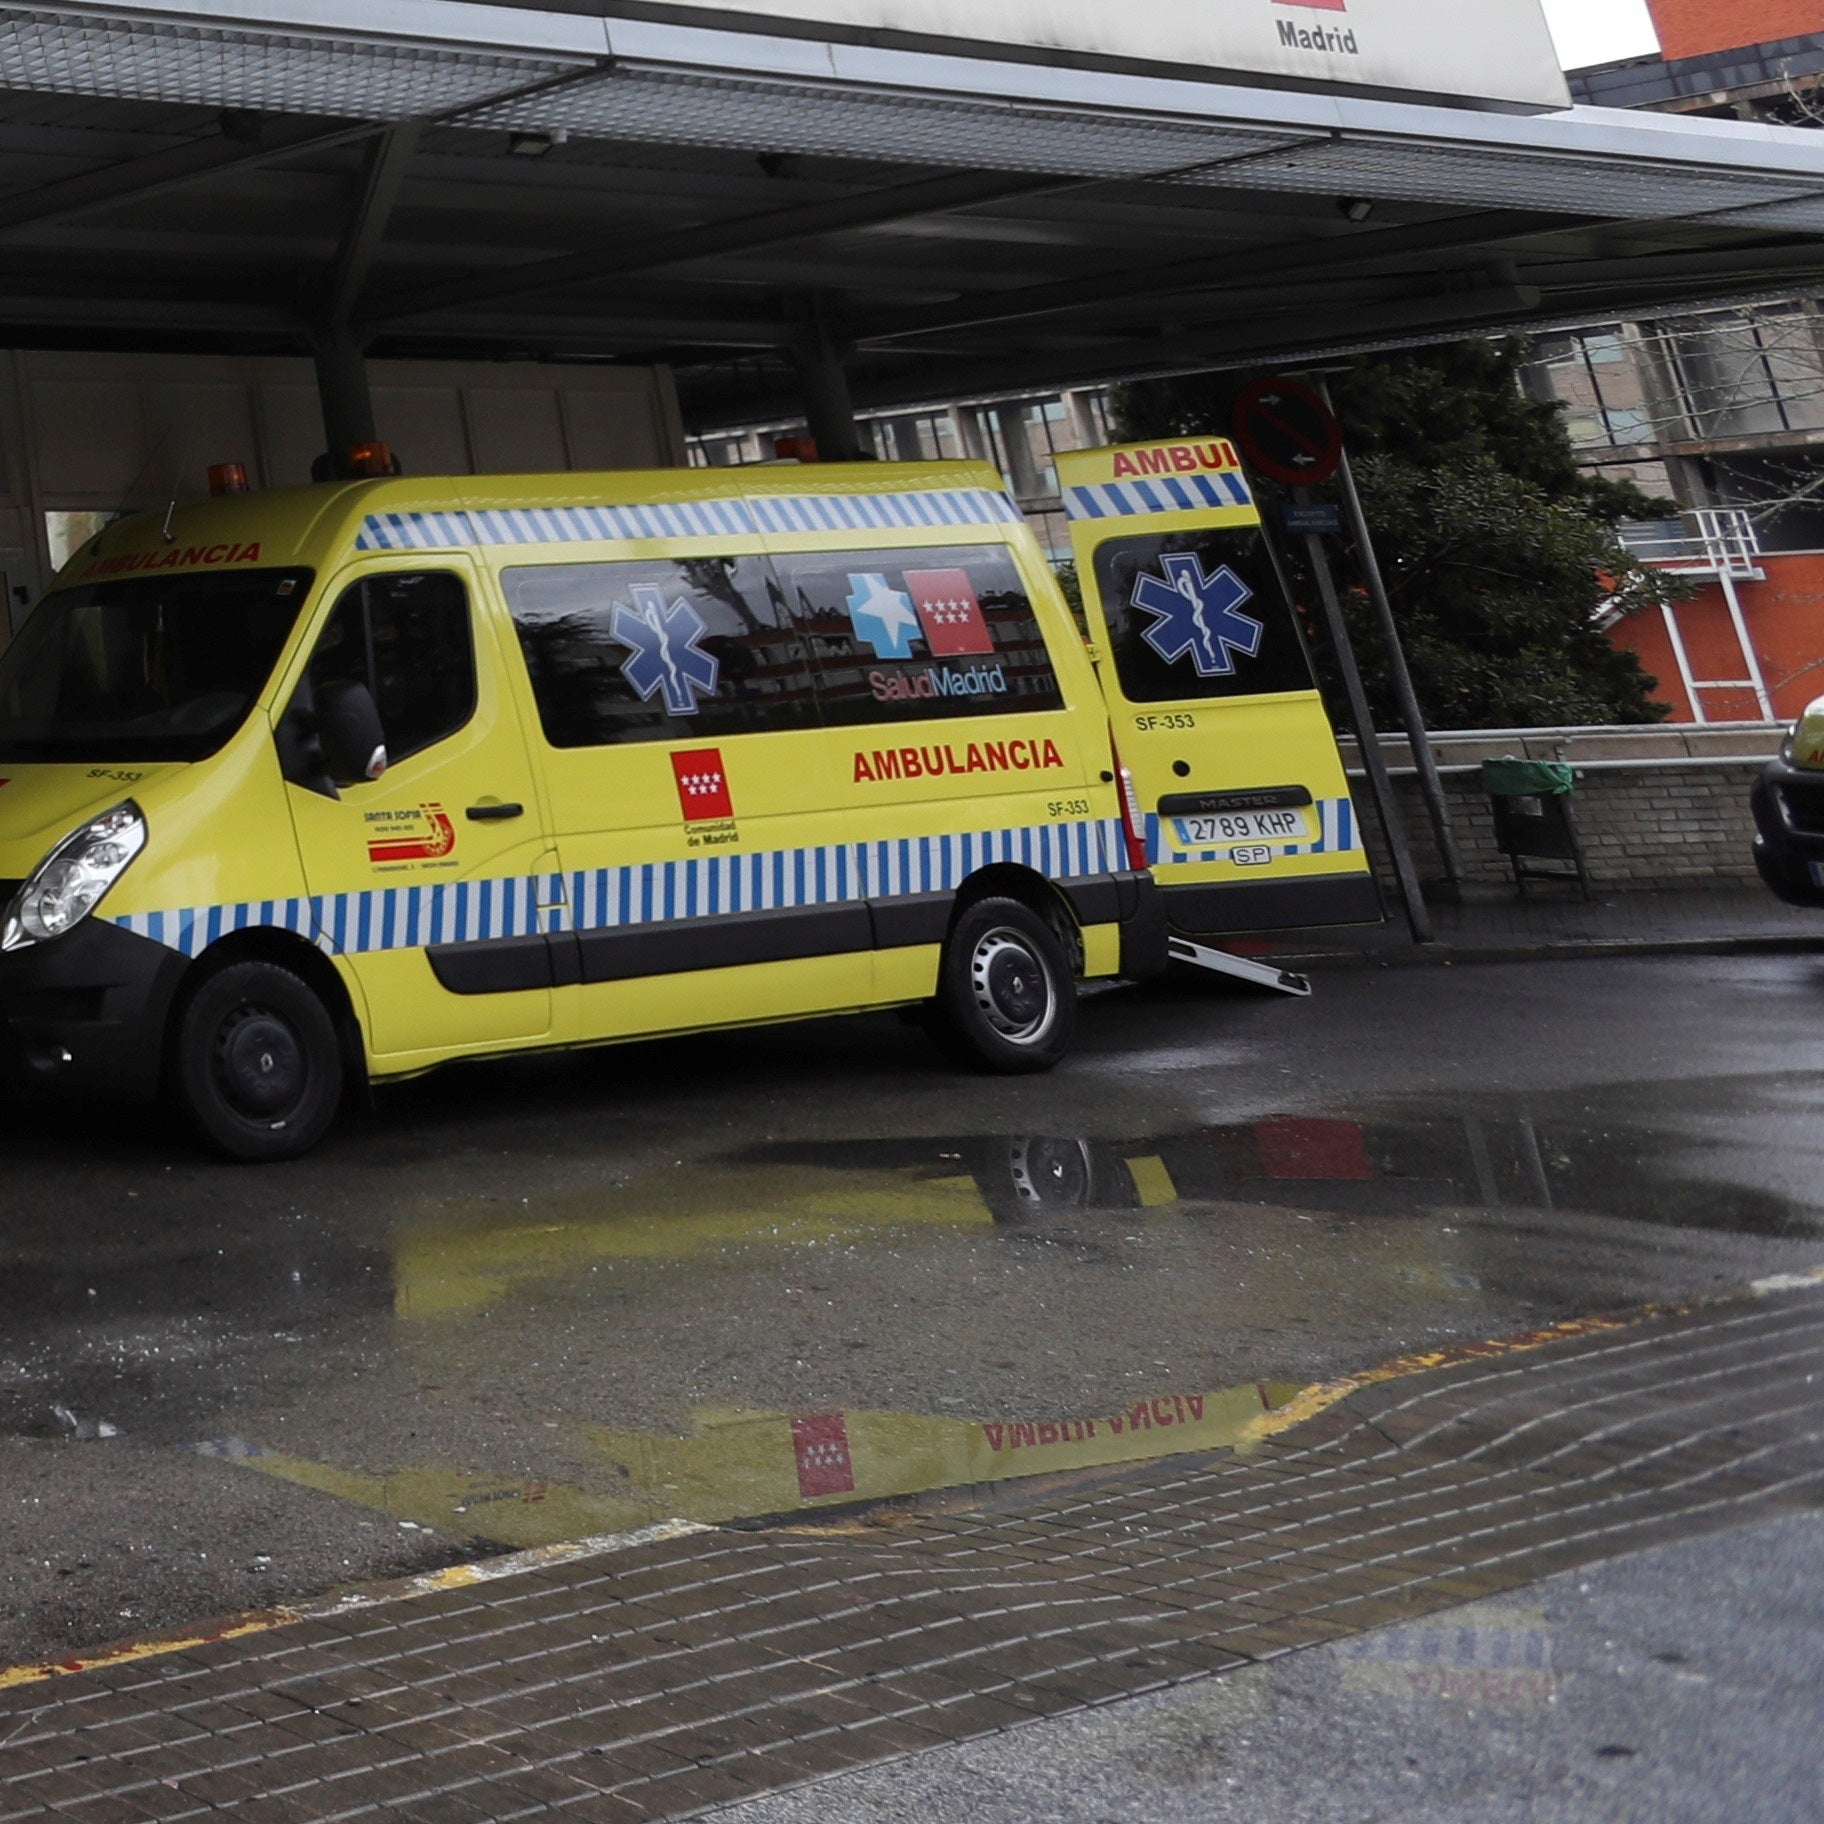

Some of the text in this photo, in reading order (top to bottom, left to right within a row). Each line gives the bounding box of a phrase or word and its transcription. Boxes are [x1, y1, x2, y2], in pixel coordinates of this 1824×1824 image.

[1275, 19, 1359, 55] Madrid
[80, 542, 261, 578] AMBULANCIA
[868, 663, 1008, 703] SaludMadrid
[1135, 714, 1196, 731] SF-353
[853, 739, 1065, 783] AMBULANCIA
[1047, 799, 1090, 817] SF-353
[1198, 794, 1278, 811] MASTER
[1188, 812, 1296, 841] 2789 KHP
[687, 831, 740, 847] de Madrid
[1236, 847, 1267, 864] SP
